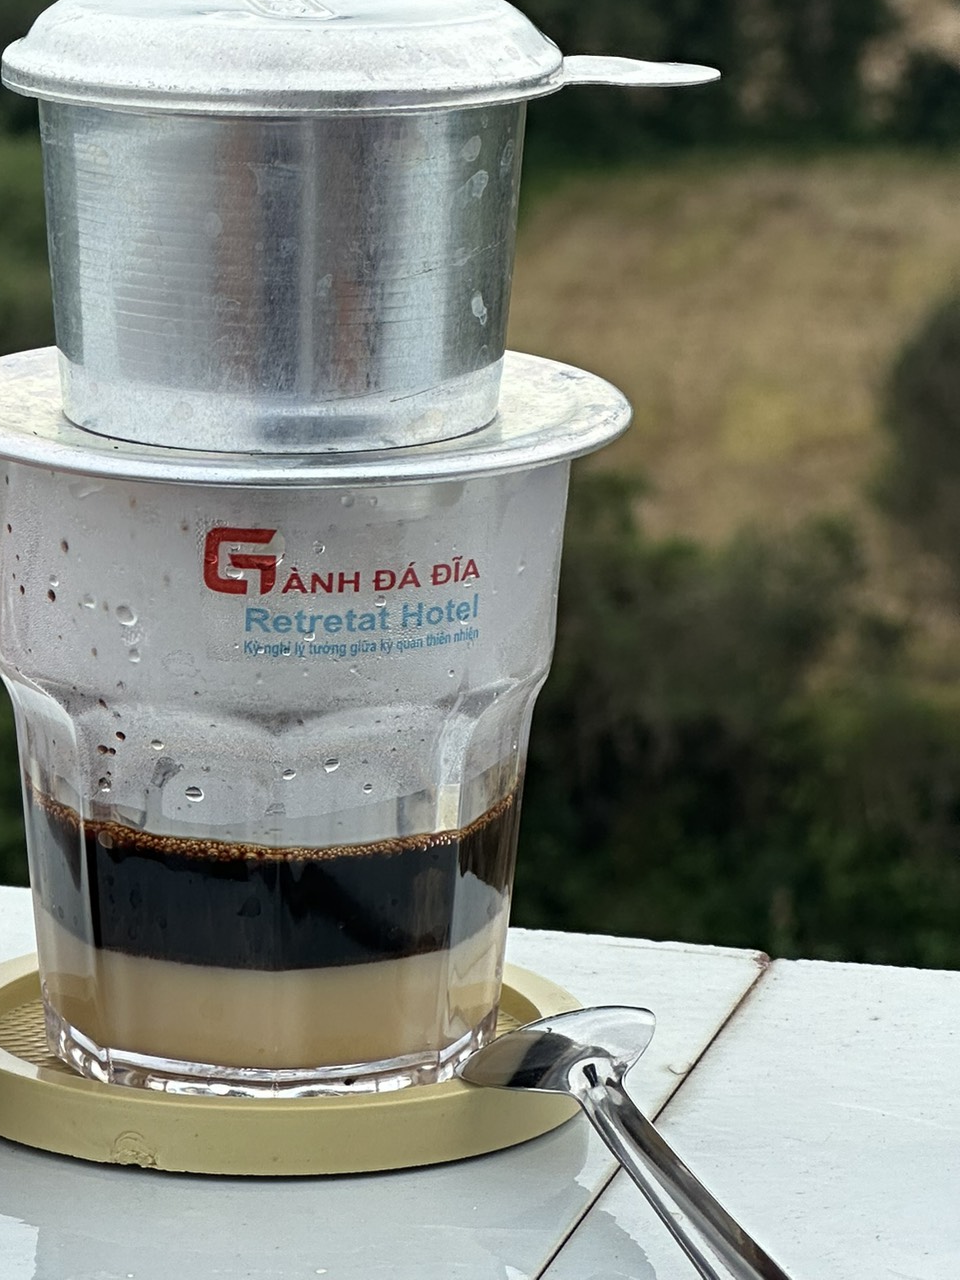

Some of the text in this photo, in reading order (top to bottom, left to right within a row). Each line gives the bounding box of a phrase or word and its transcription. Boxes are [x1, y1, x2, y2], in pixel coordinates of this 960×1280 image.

[372, 561, 421, 591] ĐÁ
[431, 556, 480, 586] ĐĨA
[244, 593, 479, 633] Retretat Hotel
[426, 632, 451, 647] thiên
